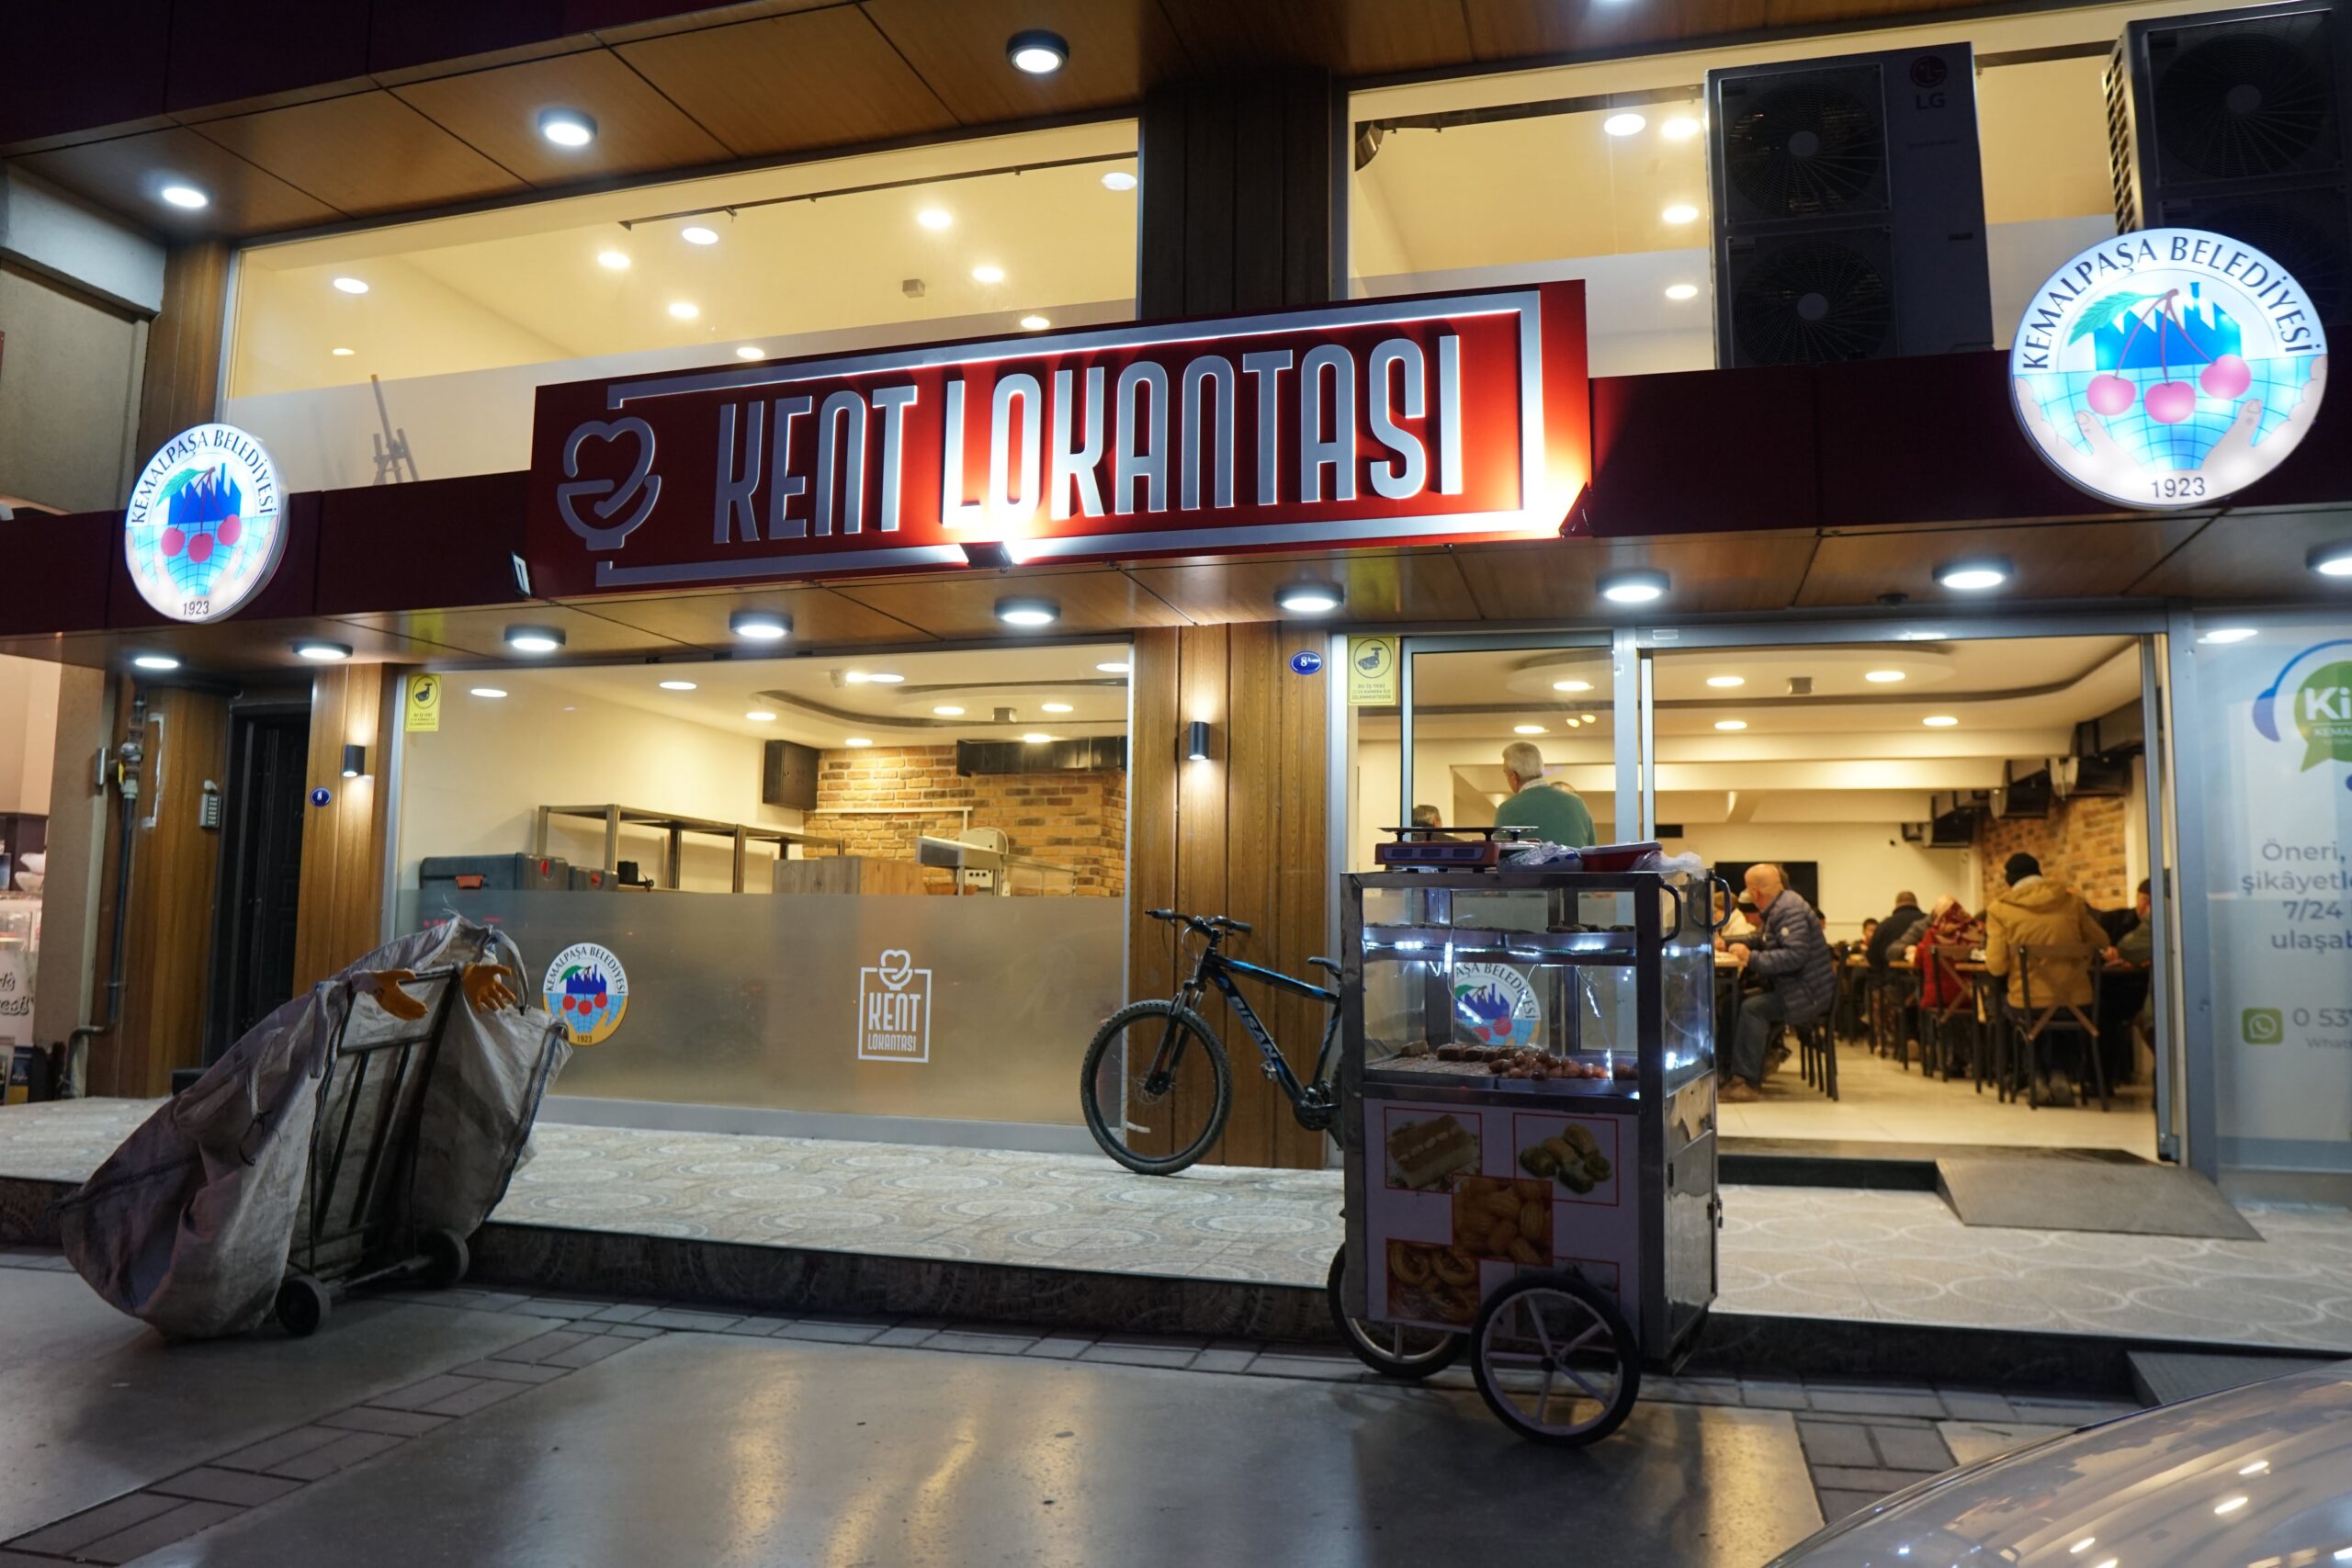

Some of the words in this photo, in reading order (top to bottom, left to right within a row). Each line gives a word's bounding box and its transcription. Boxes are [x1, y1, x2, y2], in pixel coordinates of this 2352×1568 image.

[1916, 93, 1946, 109] LG
[2023, 237, 2157, 369] KEMALPAŞA
[2170, 236, 2322, 353] BELEDİYESİ
[714, 383, 919, 544] KENT
[941, 334, 1464, 531] LOKANTASI
[131, 431, 208, 523] KEMALPAŞA
[213, 429, 277, 513] BELEDİYESİ
[2151, 477, 2206, 499] 1923
[183, 600, 209, 616] 1923
[2304, 686, 2352, 720] Ki
[2261, 838, 2346, 863] Öneri,
[2242, 870, 2352, 896] şikâyetl
[2282, 899, 2344, 922] 7/24
[546, 946, 587, 992] KEMALPAŞA
[590, 946, 627, 995] BELEDİYESİ
[1455, 963, 1480, 977] AŞA
[868, 992, 922, 1032] KENT
[2292, 1007, 2311, 1028] 0
[2317, 1007, 2352, 1028] 53
[577, 1035, 593, 1043] 1923
[867, 1033, 917, 1052] LOKANTASI
